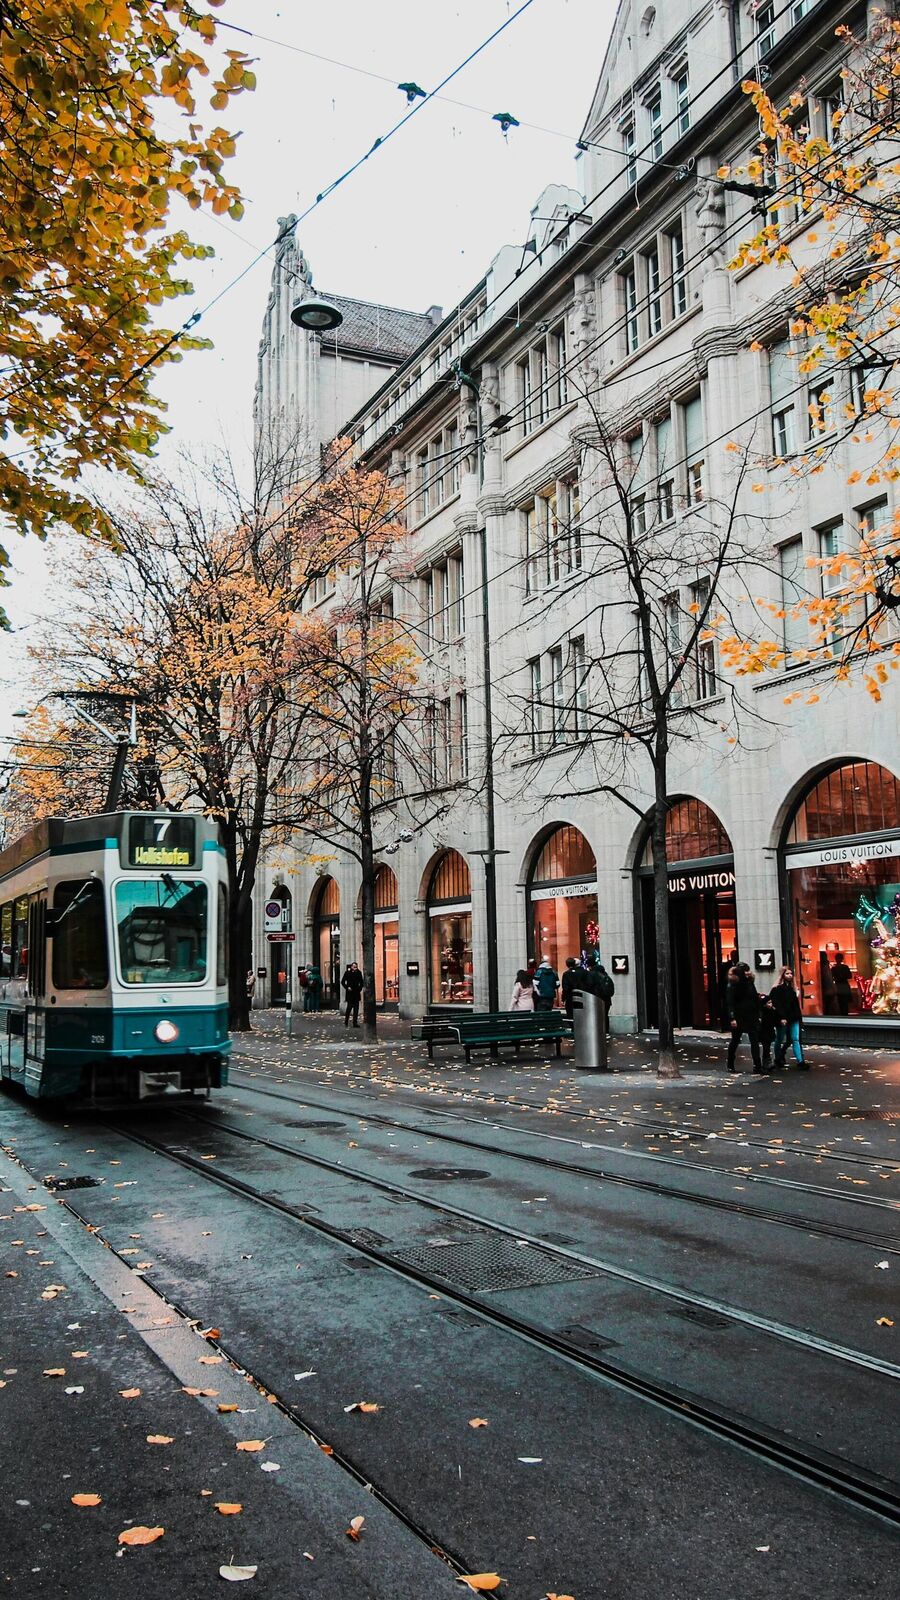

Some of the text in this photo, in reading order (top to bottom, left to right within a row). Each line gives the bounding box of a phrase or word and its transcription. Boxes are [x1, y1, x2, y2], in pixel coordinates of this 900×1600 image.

[153, 818, 172, 842] 7
[820, 844, 893, 862] LOUIS VUITTON
[549, 884, 589, 897] LOUIS VUITTON
[666, 877, 687, 893] UIS
